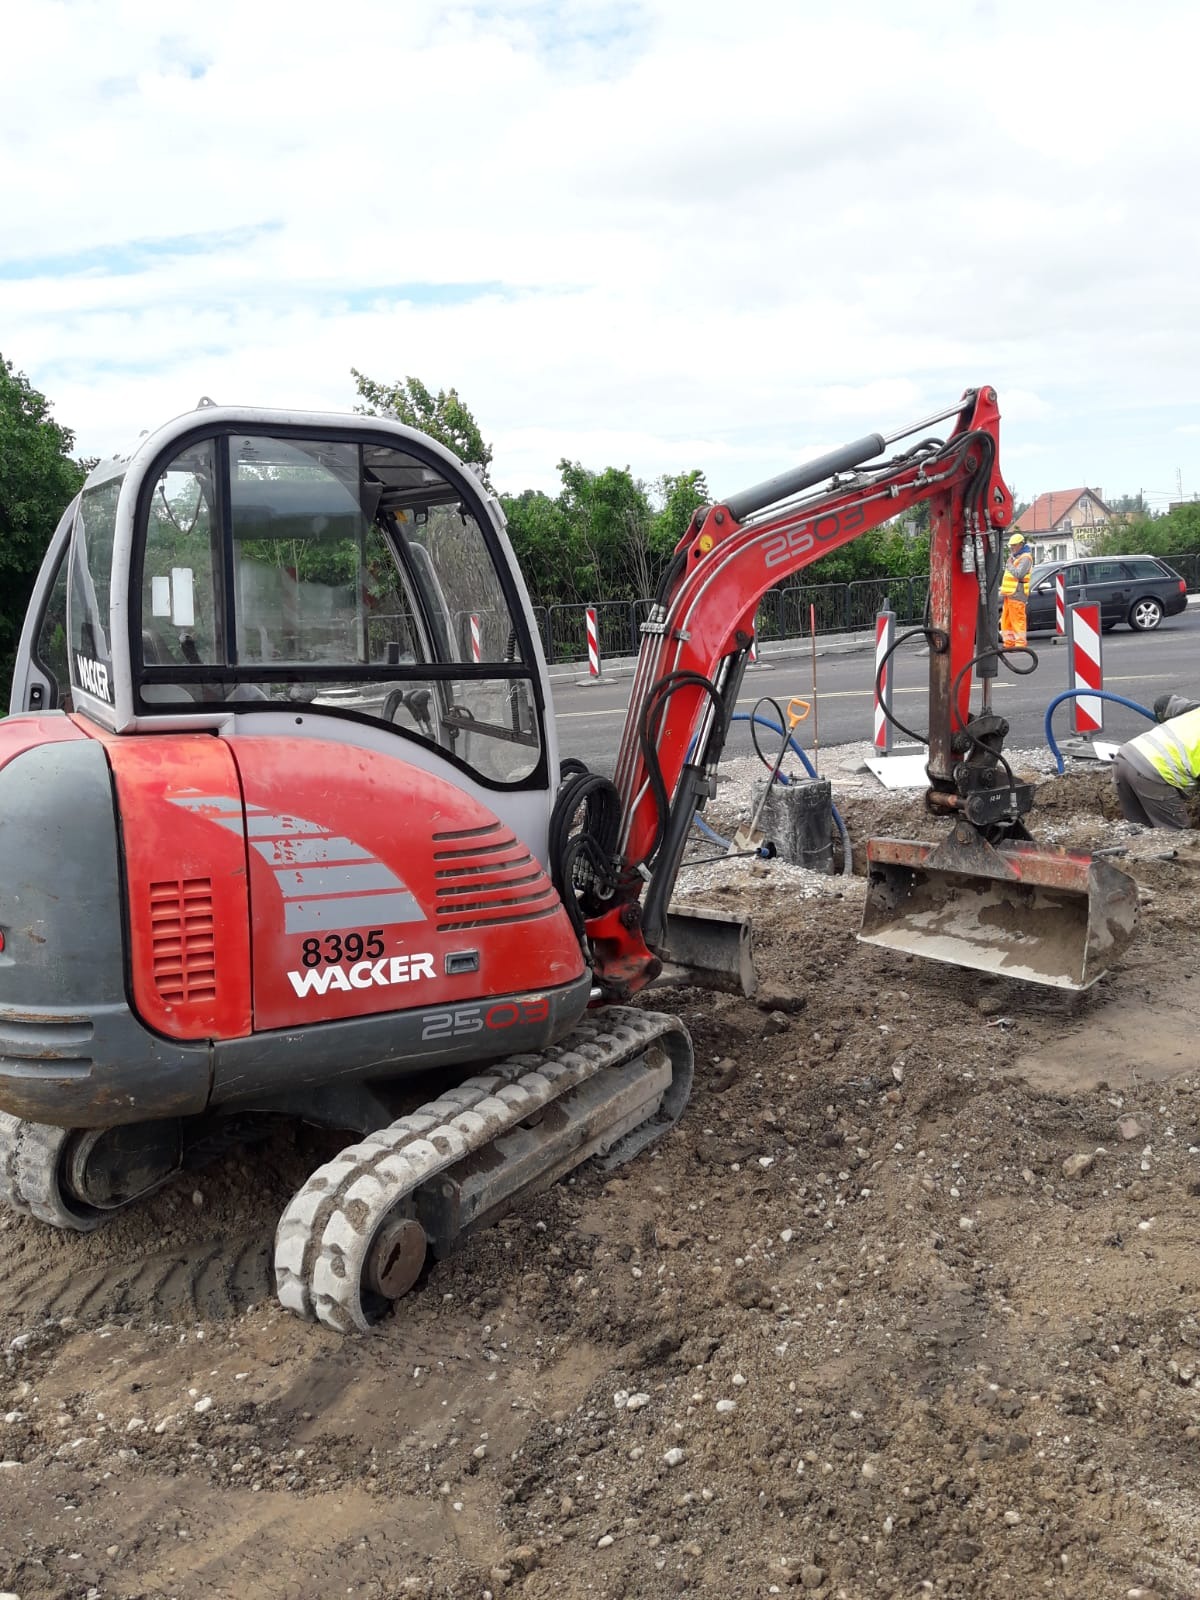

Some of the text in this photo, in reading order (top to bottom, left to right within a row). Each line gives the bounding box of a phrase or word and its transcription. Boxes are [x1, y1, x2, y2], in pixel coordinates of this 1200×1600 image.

[761, 505, 865, 568] 2503
[77, 653, 111, 702] WACKER
[302, 930, 385, 968] 8395
[287, 953, 437, 998] WACKER
